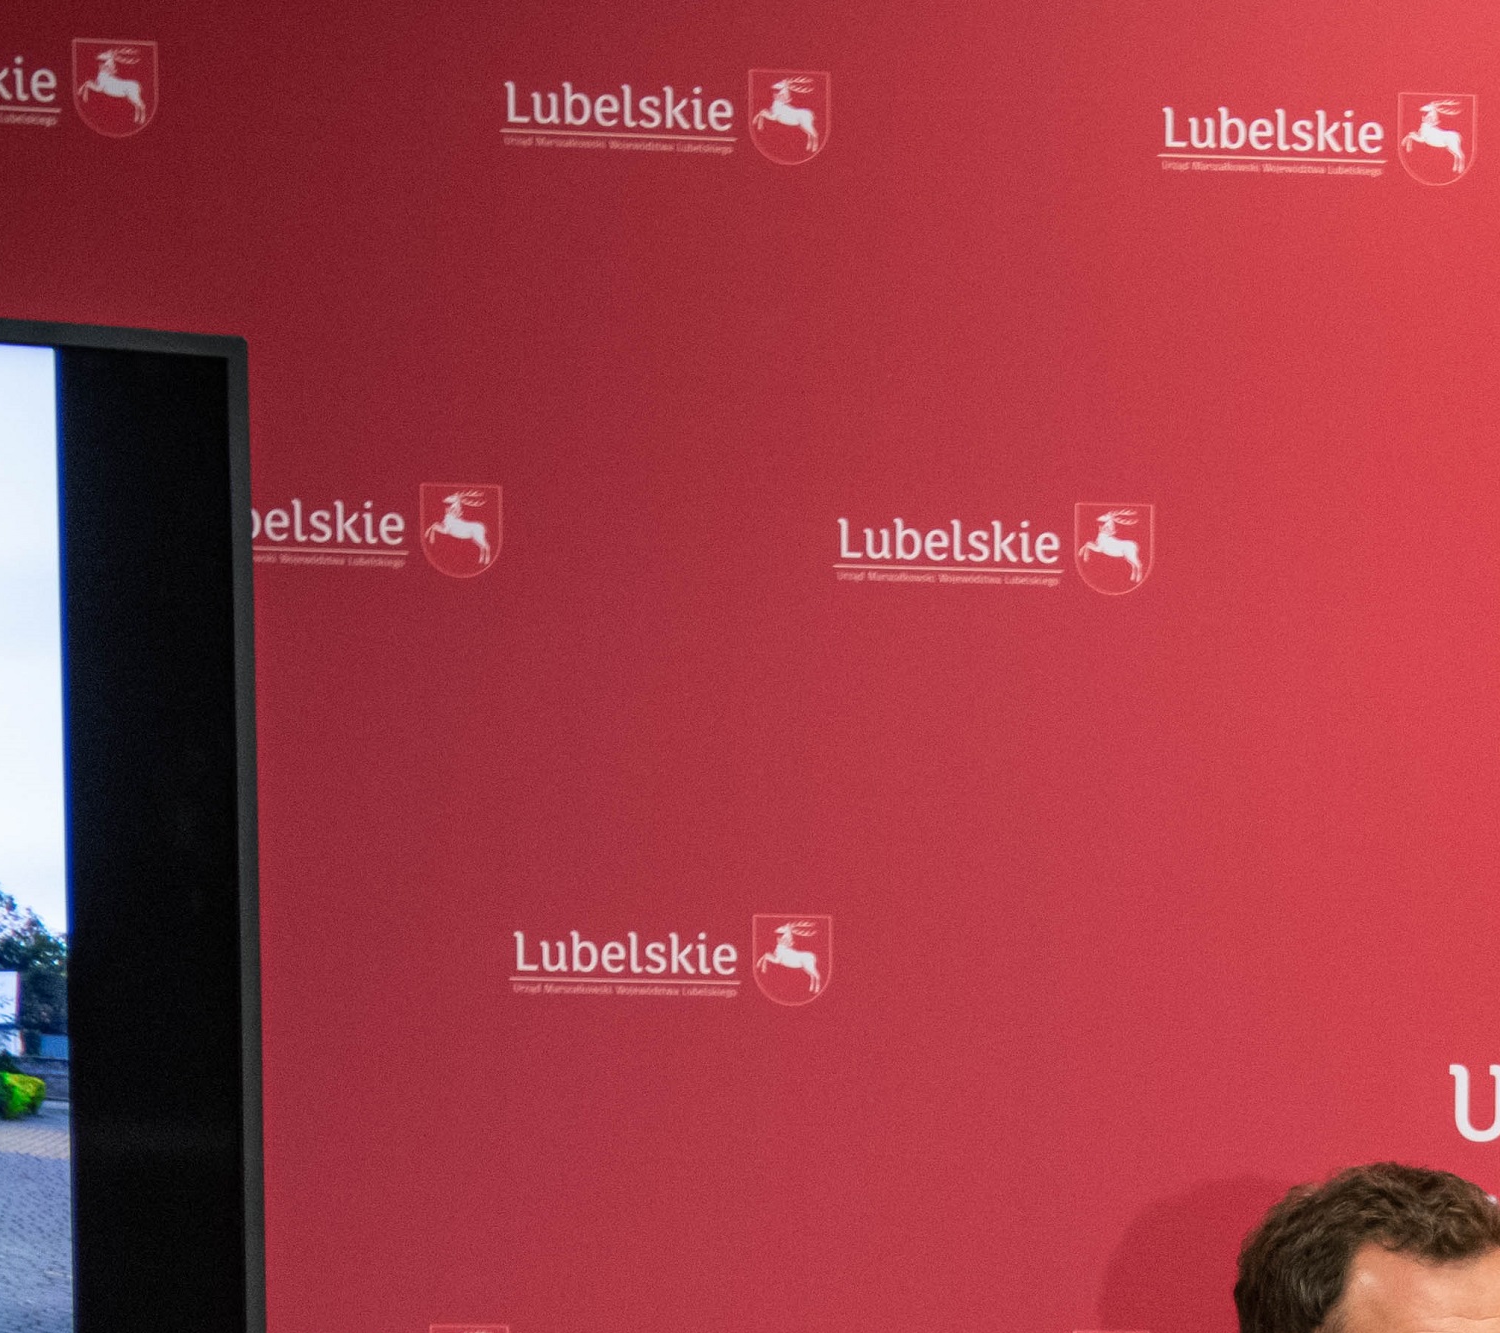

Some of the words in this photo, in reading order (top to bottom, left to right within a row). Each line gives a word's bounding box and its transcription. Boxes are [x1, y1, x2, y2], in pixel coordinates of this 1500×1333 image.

[504, 82, 734, 131] Lubelskie
[1162, 107, 1384, 153] Lubelskie
[251, 499, 405, 545] elskie
[837, 518, 1060, 564] Lubelskie
[513, 930, 738, 975] Lubelskie
